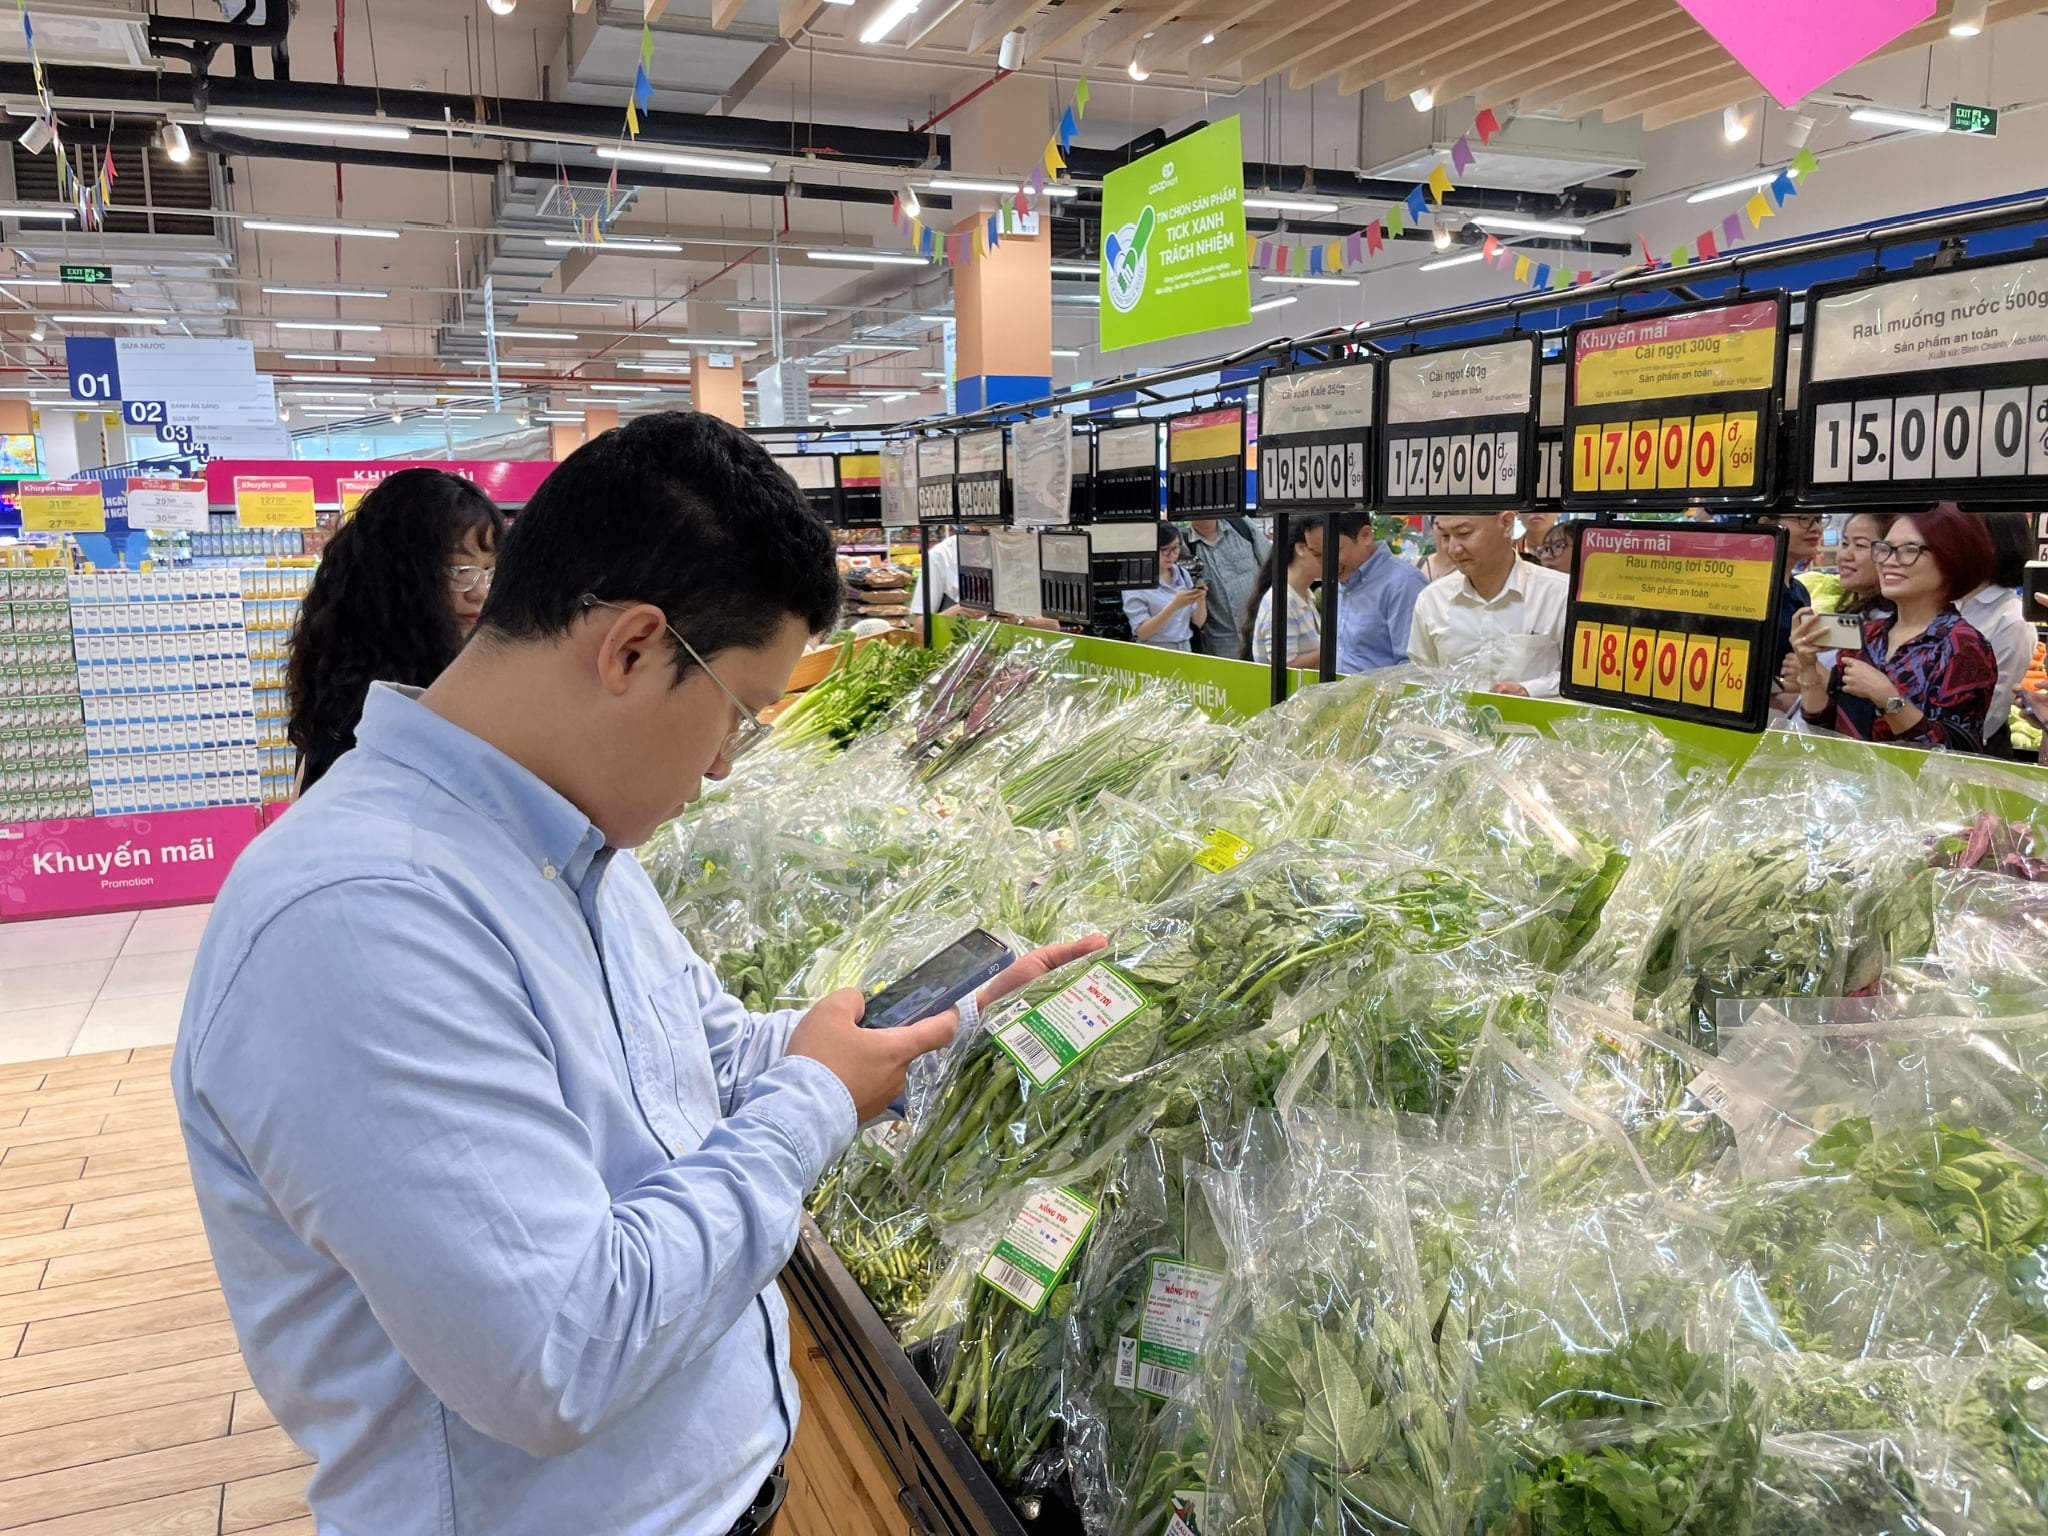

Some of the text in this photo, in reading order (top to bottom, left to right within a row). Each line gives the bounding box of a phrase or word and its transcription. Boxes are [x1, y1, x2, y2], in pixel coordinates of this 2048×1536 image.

[1956, 108, 1971, 118] EXIT
[1156, 185, 1237, 225] TIN CHỌN SẢN PHẨM
[1166, 210, 1225, 243] TICK XANH
[1160, 231, 1235, 267] TRÁCH NHIỆM
[1853, 290, 2048, 340] Rau muống nước 500g
[1580, 320, 1668, 350] Khuyến mãi
[1635, 338, 1721, 359] Cải ngọt 300g
[1894, 326, 1999, 354] Sản phẩm an toàn
[78, 373, 111, 397] 01
[1445, 368, 1465, 383] ngọt
[1639, 368, 1713, 384] Sản phẩm an toàn
[131, 402, 162, 423] 02
[162, 425, 188, 441] 03
[1828, 402, 2023, 469] 15.000
[1395, 442, 1491, 486] 17.900
[1583, 424, 1716, 477] 17.900
[1267, 453, 1341, 491] 19.500
[1586, 530, 1671, 552] Khuyến mãi
[1626, 556, 1648, 569] Rau
[1684, 558, 1702, 572] tơi
[1703, 560, 1735, 577] 500g
[1641, 583, 1709, 599] Sản phẩm an toàn
[1582, 630, 1709, 692] 18.900
[32, 837, 215, 876] Khuyến mãi
[101, 876, 154, 889] Promotion
